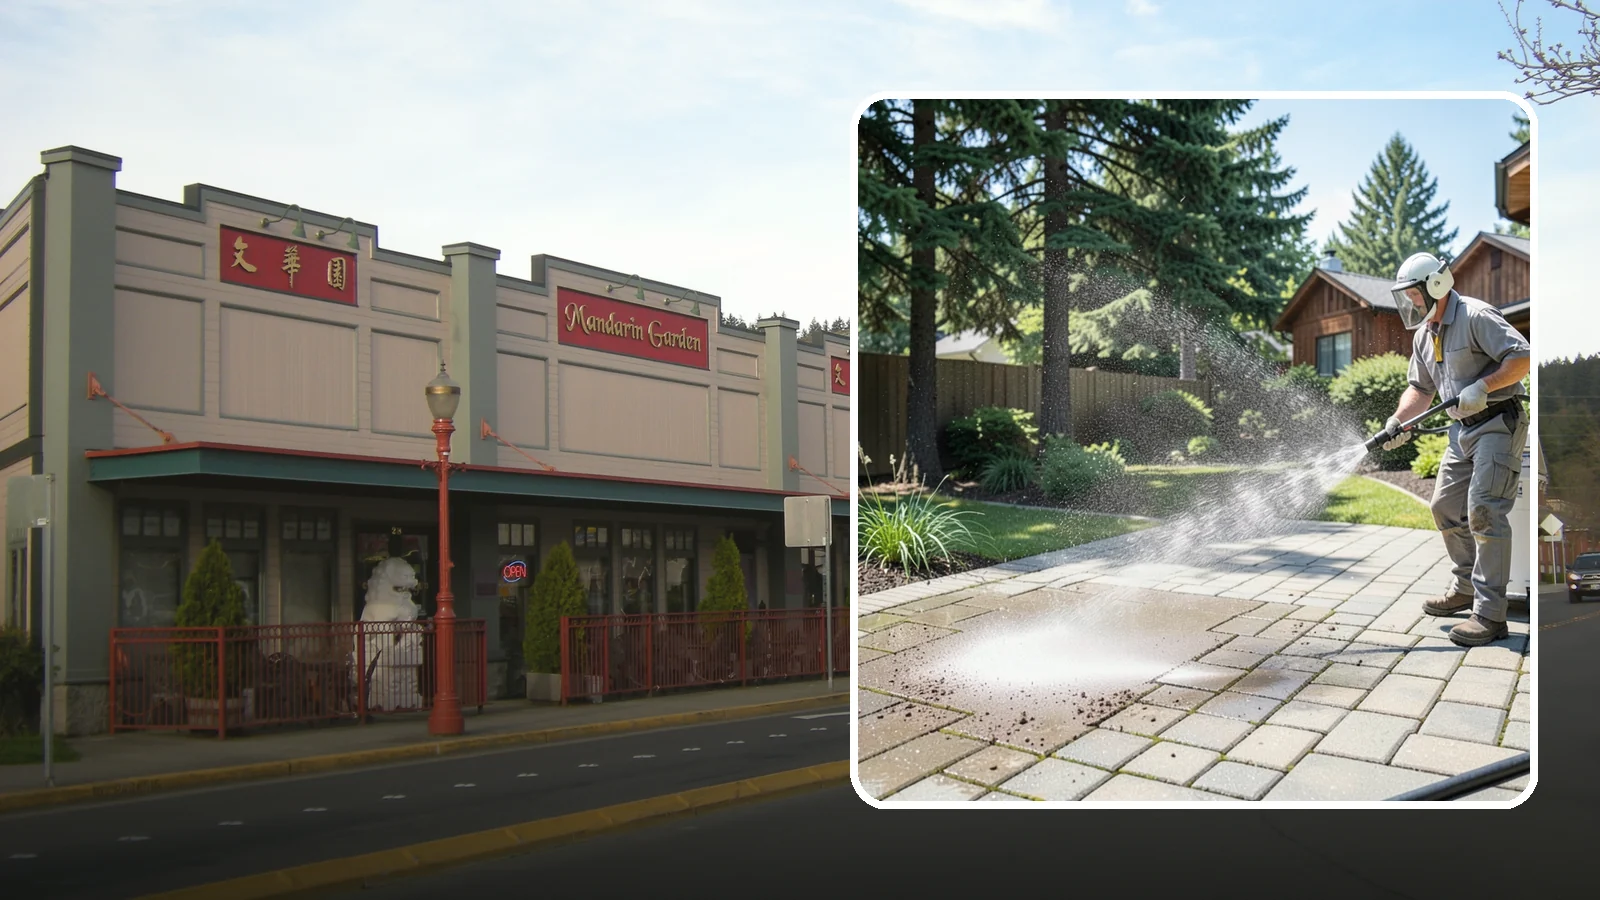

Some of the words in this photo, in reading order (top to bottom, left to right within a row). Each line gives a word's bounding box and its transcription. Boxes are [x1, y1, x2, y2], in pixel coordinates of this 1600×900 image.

[231, 236, 346, 290] 文華園
[564, 303, 644, 341] Mandarin
[648, 320, 701, 352] Garden
[503, 565, 527, 578] OPEN
